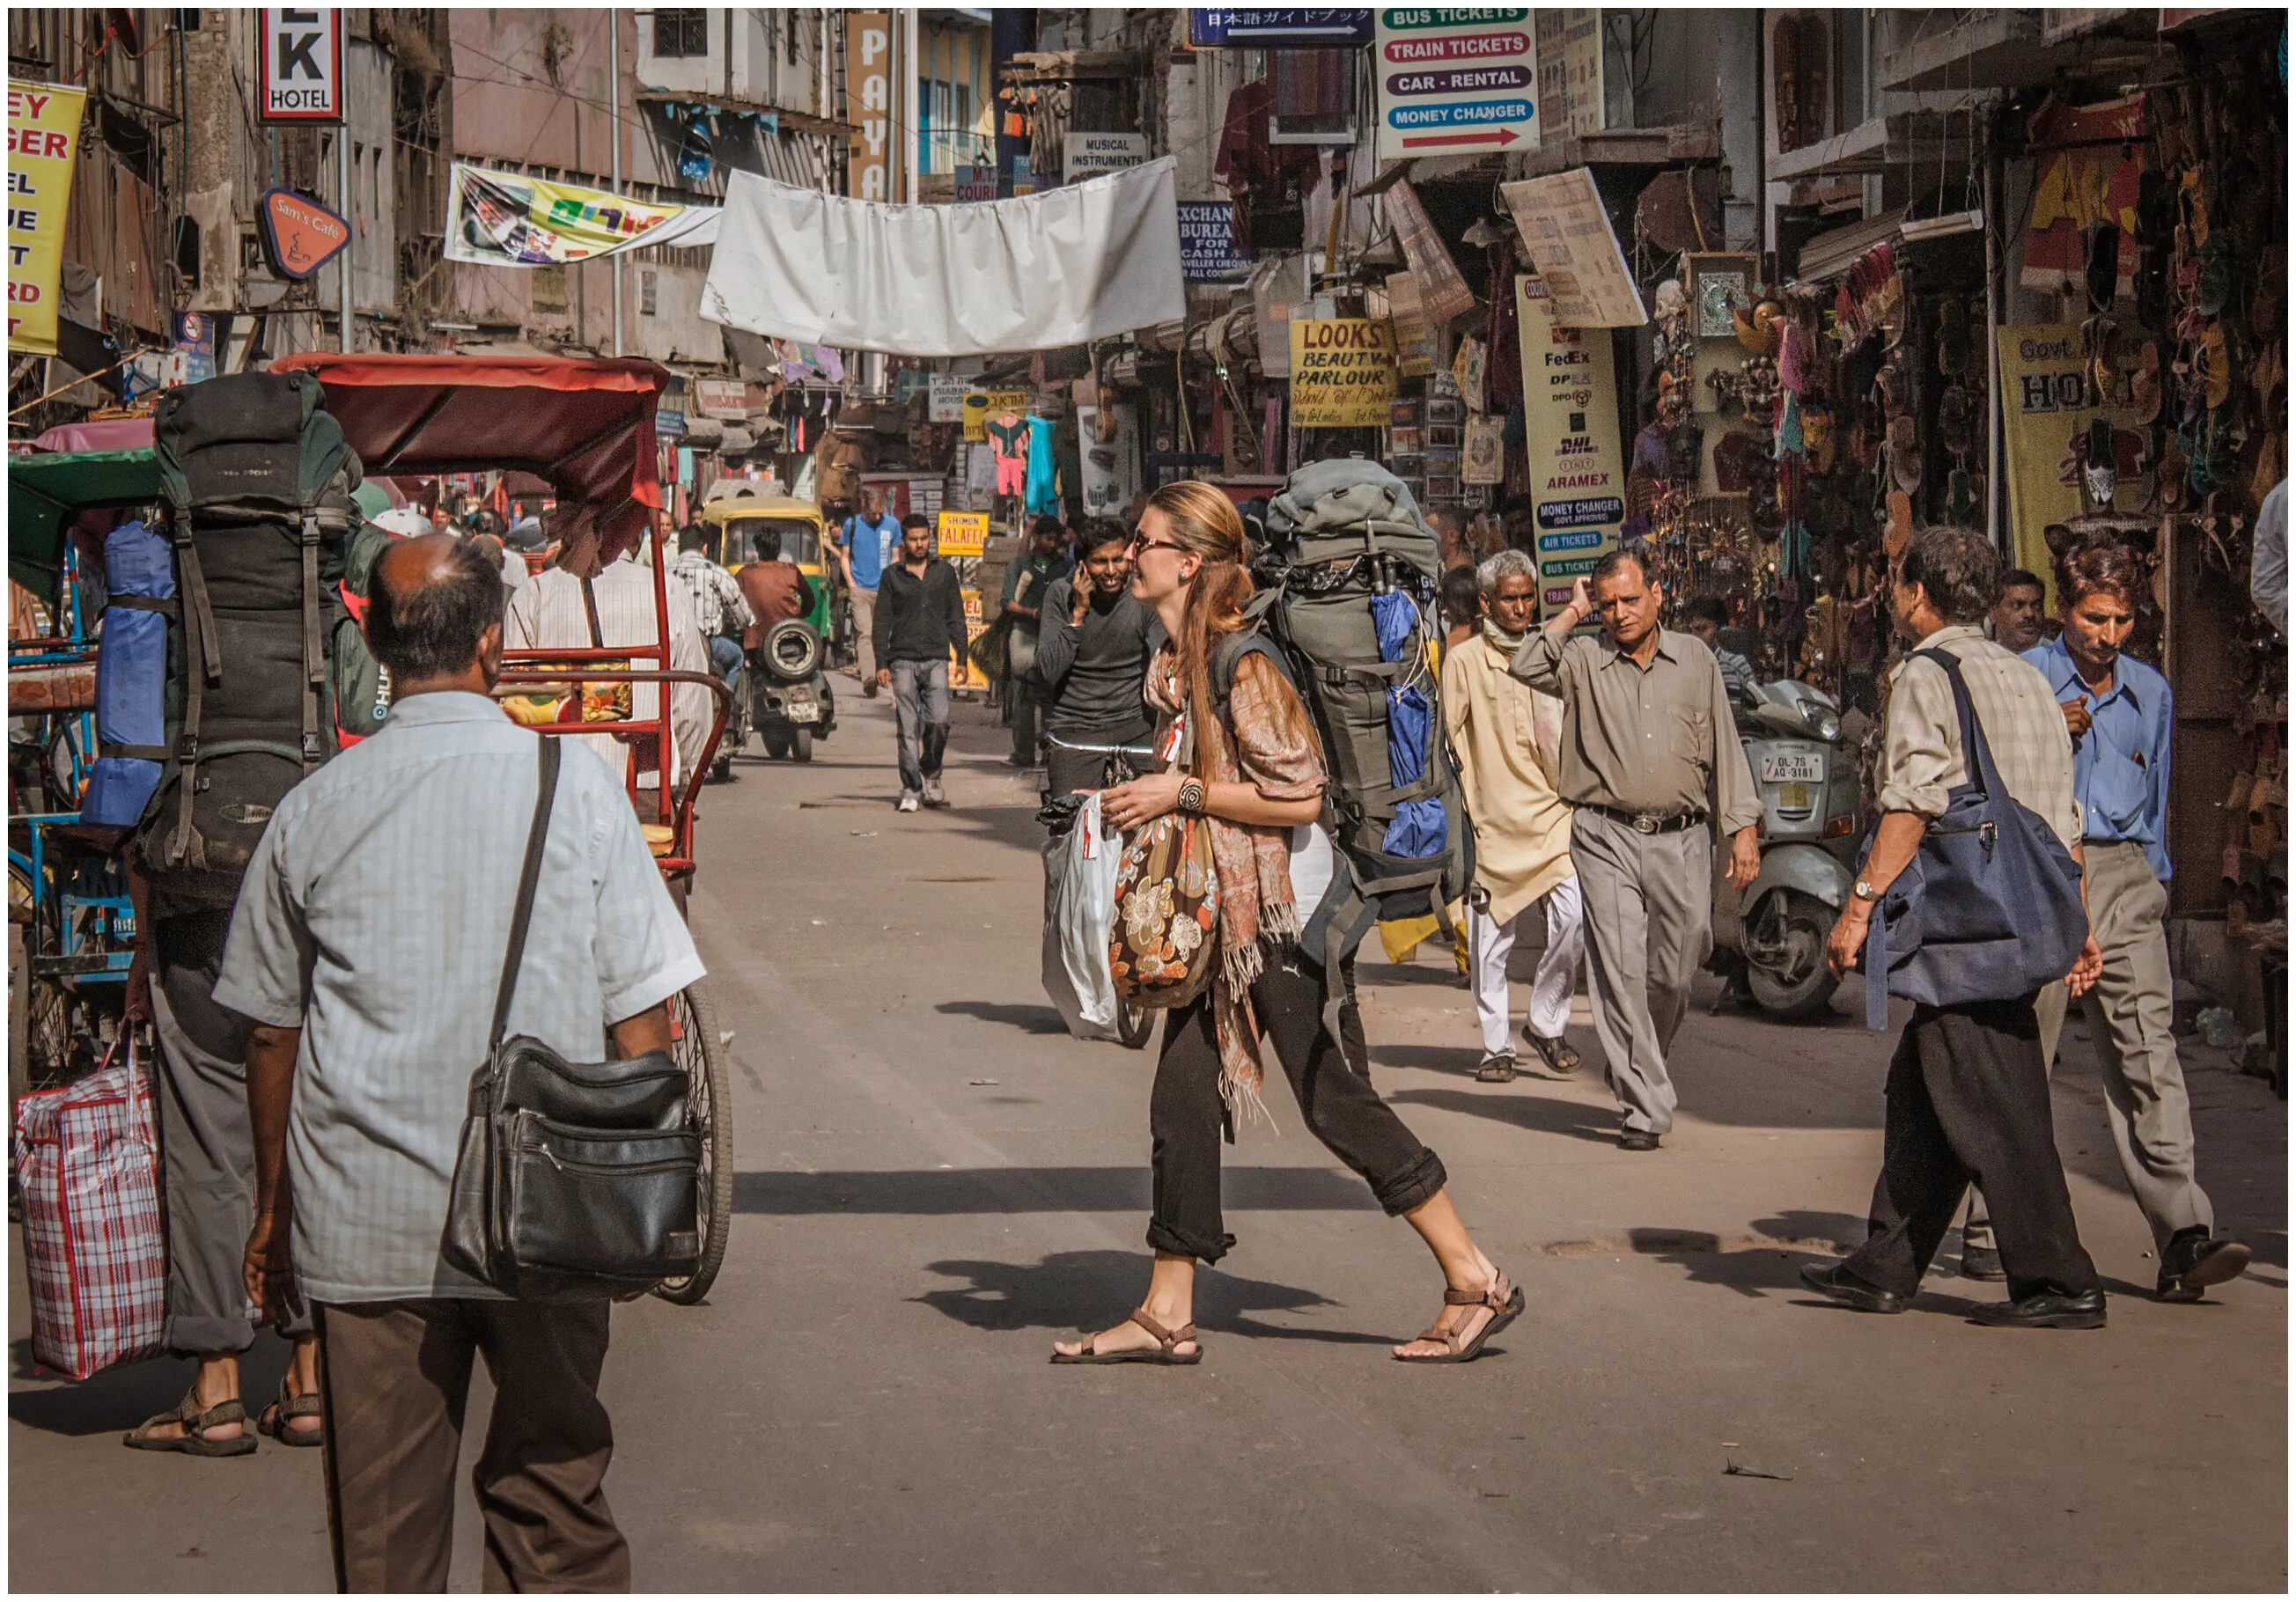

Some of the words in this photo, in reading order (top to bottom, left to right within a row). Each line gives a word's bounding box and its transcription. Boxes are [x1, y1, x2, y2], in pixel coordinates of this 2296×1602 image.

[1208, 10, 1369, 27] 日本語ガイドブック
[1394, 11, 1431, 26] BUS
[1437, 7, 1519, 23] TICKETS
[1391, 42, 1445, 59] TRAIN
[1449, 36, 1524, 55] TICKETS
[1398, 77, 1435, 92] CAR
[1451, 70, 1521, 88] RENTAL
[271, 90, 329, 108] HOTEL
[1395, 109, 1449, 124] MONEY
[1453, 104, 1527, 121] CHANGER
[1085, 139, 1130, 151] MUSICAL
[1072, 155, 1144, 167] INSTRUMENTS
[276, 199, 309, 226] Sam's
[312, 217, 339, 239] Café
[1176, 206, 1233, 222] XCHAN
[1196, 239, 1229, 248] FOR
[1181, 249, 1225, 259] CASH
[1304, 323, 1384, 349] LOOKS
[1303, 352, 1382, 368] BEAUTY
[1545, 350, 1590, 367] FedEx
[1296, 370, 1385, 386] PARLOUR
[1558, 436, 1595, 456] DHL
[1547, 473, 1609, 490] ARAMEX
[1541, 503, 1573, 518] MONEY
[1575, 498, 1620, 514] CHANGER
[946, 516, 980, 525] SHIMON
[940, 527, 983, 545] FALAFEL
[1544, 538, 1558, 548] AIR
[1561, 533, 1598, 547] TICKETS
[1545, 564, 1563, 575] BUS
[1547, 591, 1571, 603] TRAIN
